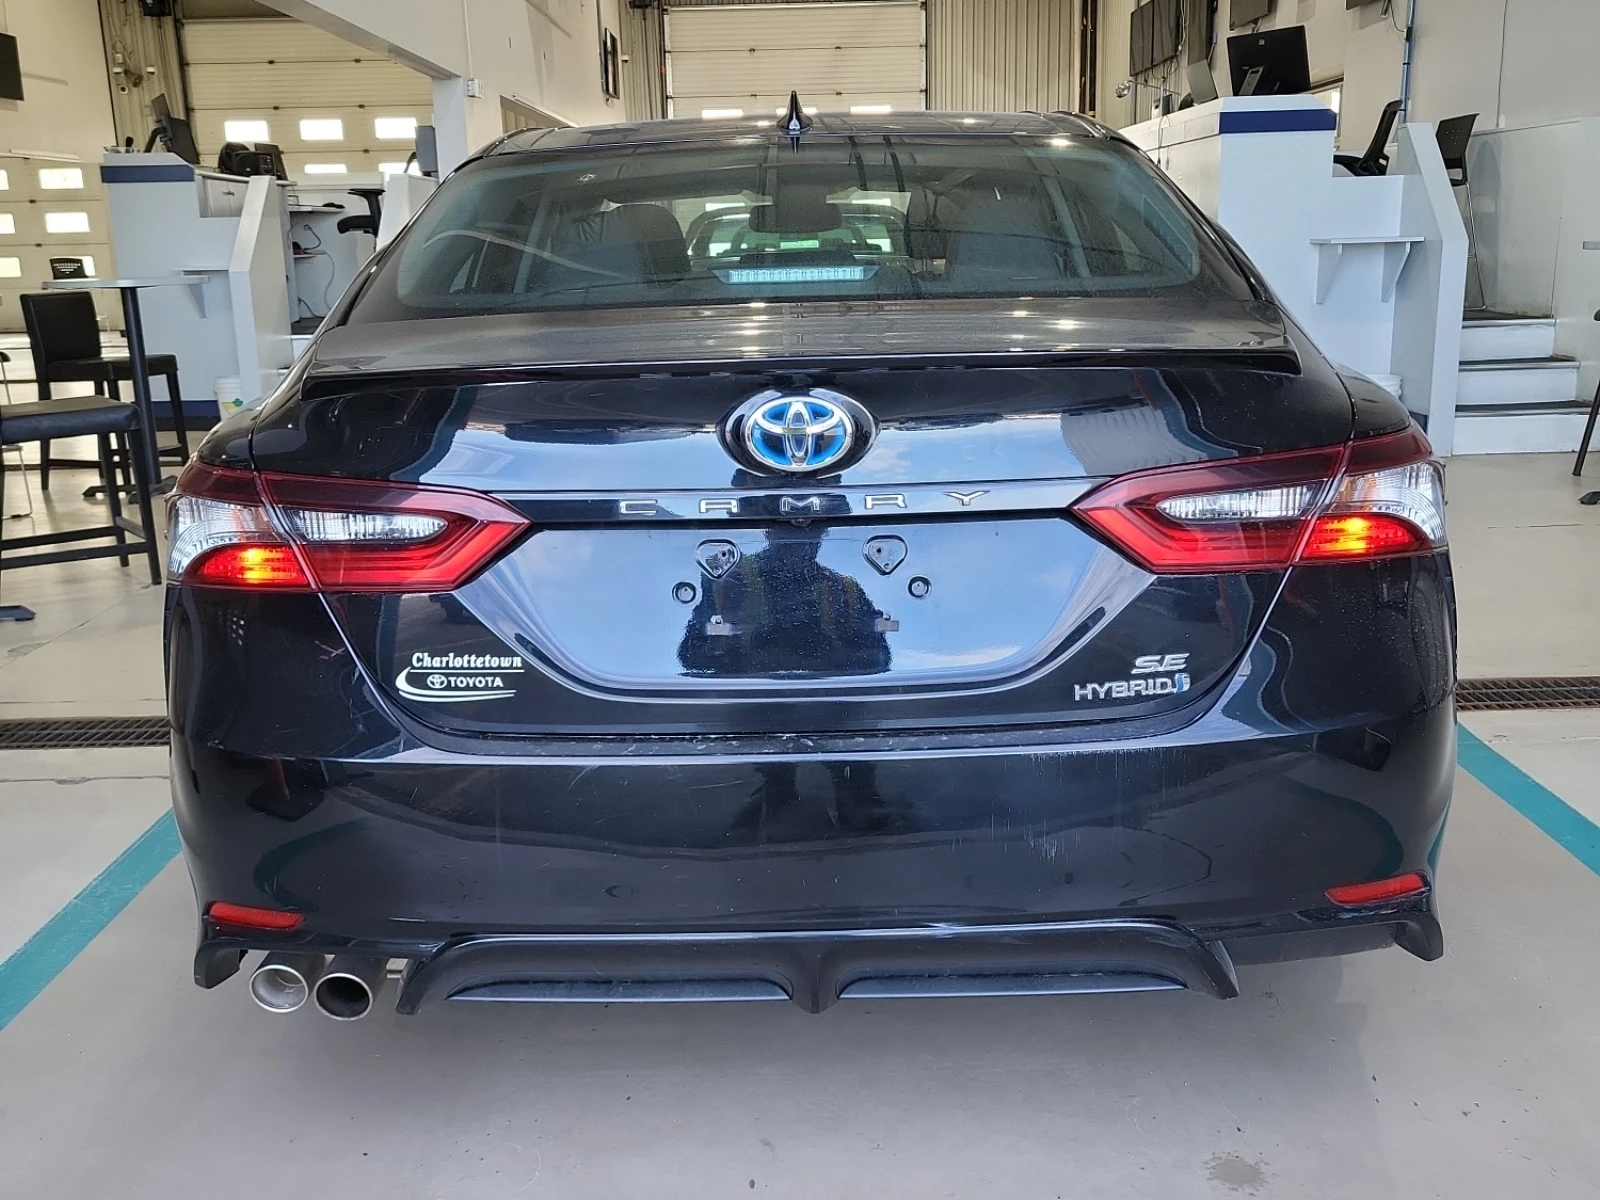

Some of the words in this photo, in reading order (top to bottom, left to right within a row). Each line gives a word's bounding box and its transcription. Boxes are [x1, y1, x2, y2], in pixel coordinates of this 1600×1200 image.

[619, 491, 990, 514] CAMRY
[412, 653, 522, 667] Charlottetown
[1131, 653, 1190, 673] SE
[448, 677, 504, 688] TOYOTA
[1074, 678, 1173, 701] HYBRID
